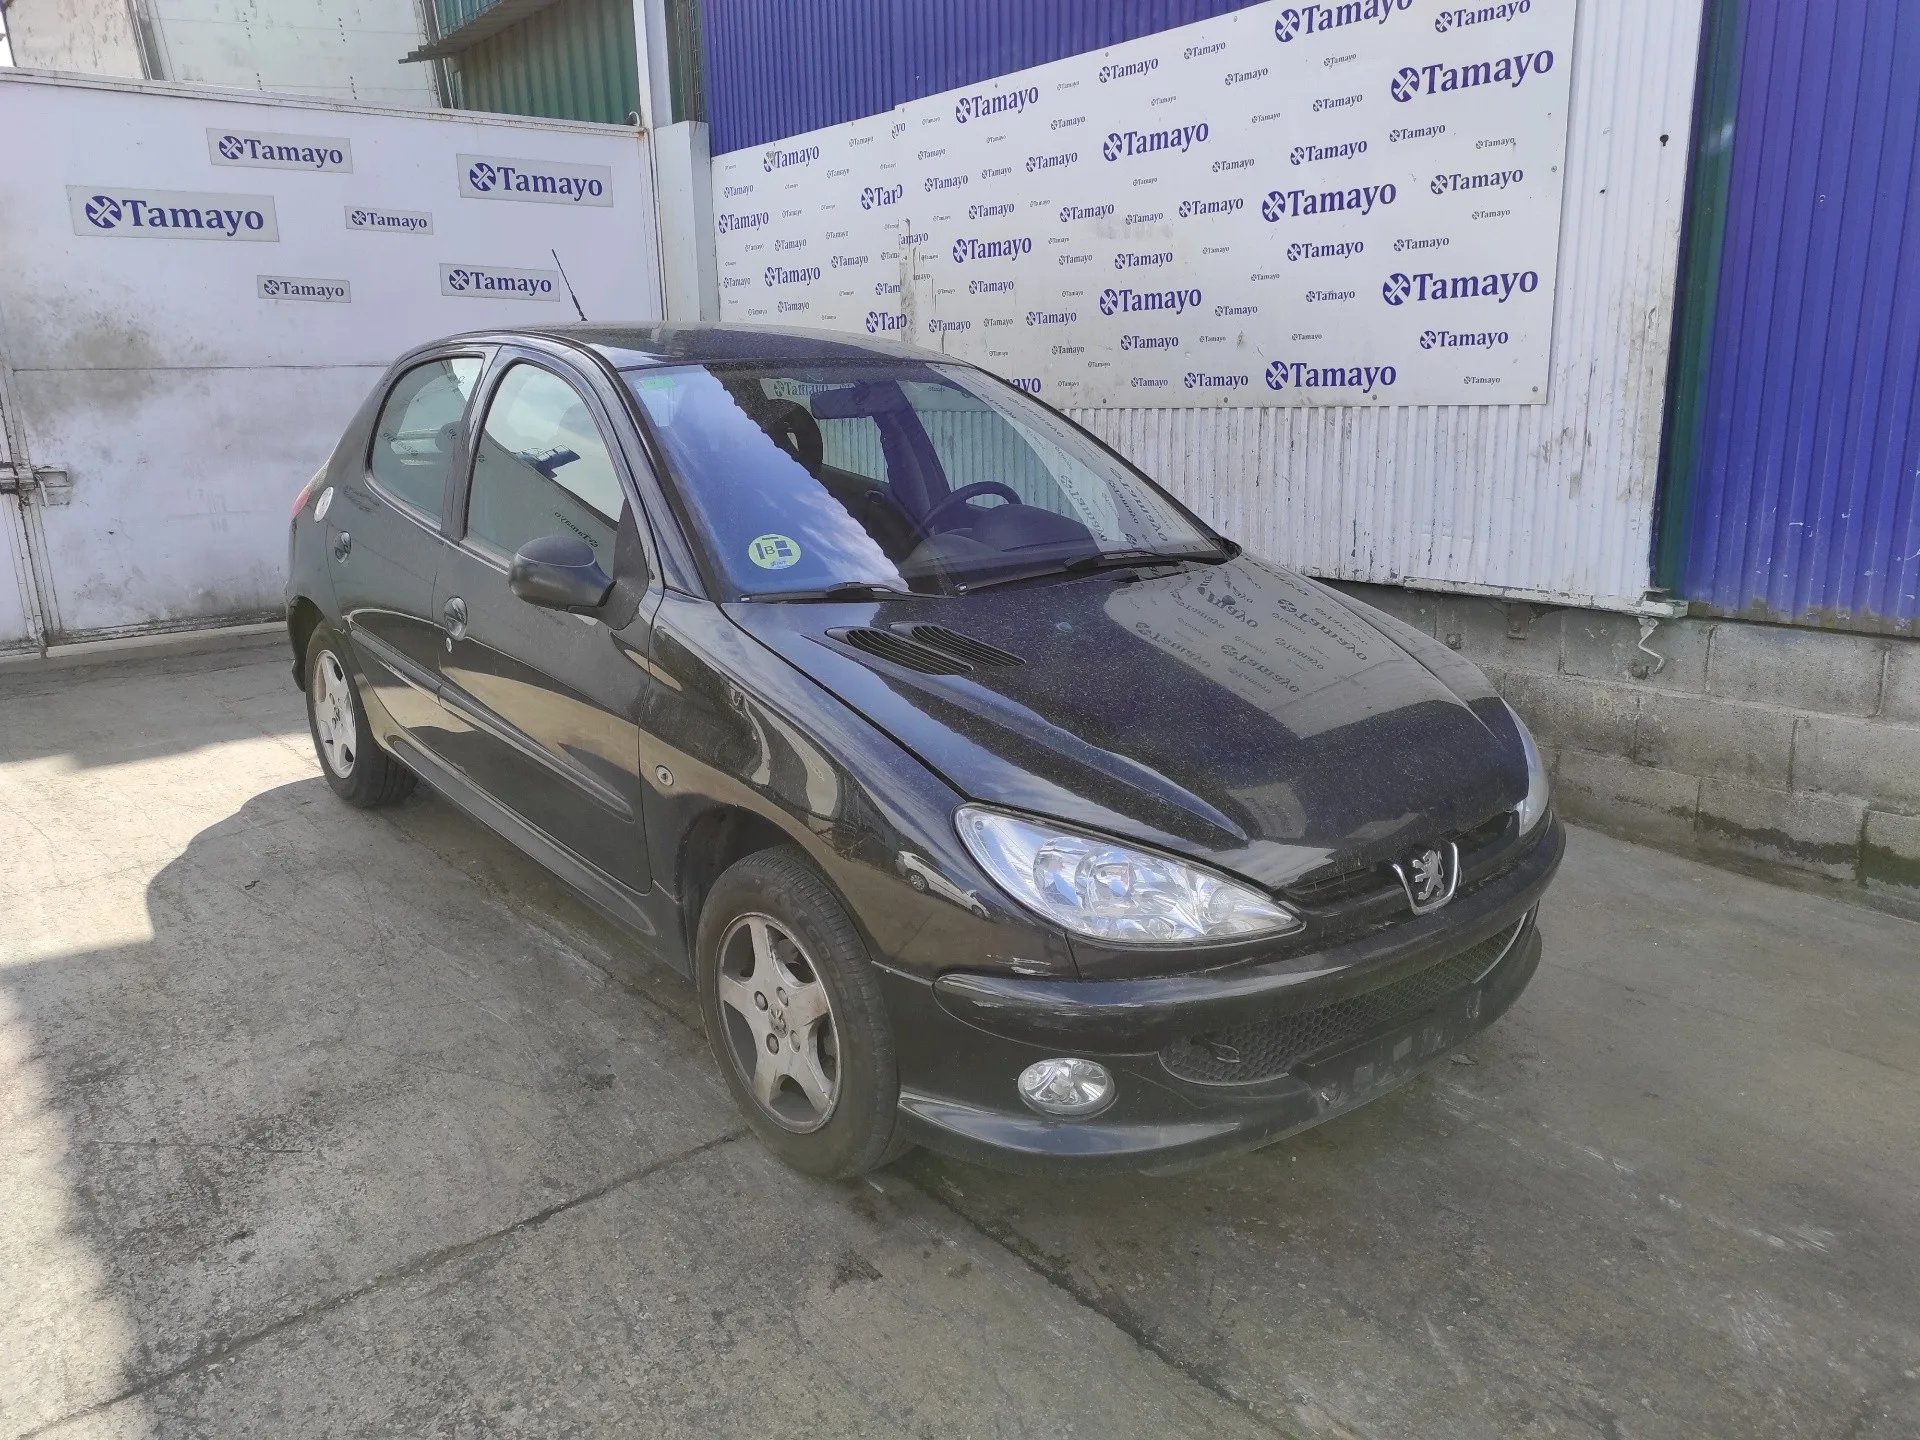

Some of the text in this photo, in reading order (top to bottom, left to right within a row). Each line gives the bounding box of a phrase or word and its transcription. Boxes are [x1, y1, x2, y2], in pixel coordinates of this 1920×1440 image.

[1301, 0, 1412, 34] Tamayo
[1454, 0, 1530, 28] Tamayo
[1192, 42, 1226, 58] Tamayo
[1330, 54, 1356, 66] Tamayo
[1111, 58, 1158, 78] Tamayo
[1422, 49, 1554, 94] Tamayo
[1233, 68, 1268, 84] Tamayo
[972, 86, 1038, 118] Tamayo
[1323, 94, 1363, 109] Tamayo
[1058, 116, 1085, 128] Tamayo
[1258, 112, 1280, 122] Tamayo
[1124, 122, 1209, 155] Tamayo
[1401, 125, 1445, 140] Tamayo
[1483, 137, 1515, 148] Tamayo
[244, 137, 343, 167] Tamayo
[775, 146, 819, 168] Tamayo
[923, 148, 945, 159] Tamayo
[1306, 141, 1367, 162] Tamayo
[1036, 152, 1077, 169] Tamayo
[1221, 158, 1255, 171] Tamayo
[987, 166, 1011, 177] Tamayo
[498, 166, 603, 199] Tamayo
[934, 174, 968, 190] Tamayo
[1449, 169, 1523, 191] Tamayo
[730, 185, 753, 196] Tamayo
[1192, 198, 1243, 215] Tamayo
[1288, 183, 1396, 216] Tamayo
[121, 199, 264, 237] Tamayo
[977, 203, 1014, 218] Tamayo
[1071, 203, 1114, 220] Tamayo
[1133, 212, 1163, 223] Tamayo
[1480, 209, 1510, 218] Tamayo
[367, 212, 427, 229] Tamayo
[728, 211, 769, 231] Tamayo
[781, 239, 806, 250] Tamayo
[969, 238, 1032, 261] Tamayo
[1208, 246, 1229, 254] Tamayo
[1302, 241, 1364, 259] Tamayo
[1405, 237, 1449, 250] Tamayo
[838, 255, 868, 267] Tamayo
[1065, 254, 1093, 264] Tamayo
[1126, 252, 1173, 267] Tamayo
[775, 267, 820, 285] Tamayo
[1257, 273, 1280, 281] Tamayo
[280, 282, 344, 300] Tamayo
[470, 271, 552, 297] Tamayo
[978, 281, 1014, 294] Tamayo
[1413, 270, 1538, 303] Tamayo
[1119, 288, 1202, 314] Tamayo
[1316, 290, 1355, 302] Tamayo
[784, 301, 809, 311] Tamayo
[1224, 306, 1257, 316] Tamayo
[937, 320, 971, 332] Tamayo
[989, 318, 1013, 327] Tamayo
[1036, 312, 1077, 325] Tamayo
[1132, 336, 1179, 350] Tamayo
[1438, 331, 1508, 349] Tamayo
[1057, 346, 1084, 354] Tamayo
[1139, 378, 1168, 388] Tamayo
[1197, 373, 1248, 389] Tamayo
[1290, 362, 1396, 393] Tamayo
[764, 546, 775, 554] B
